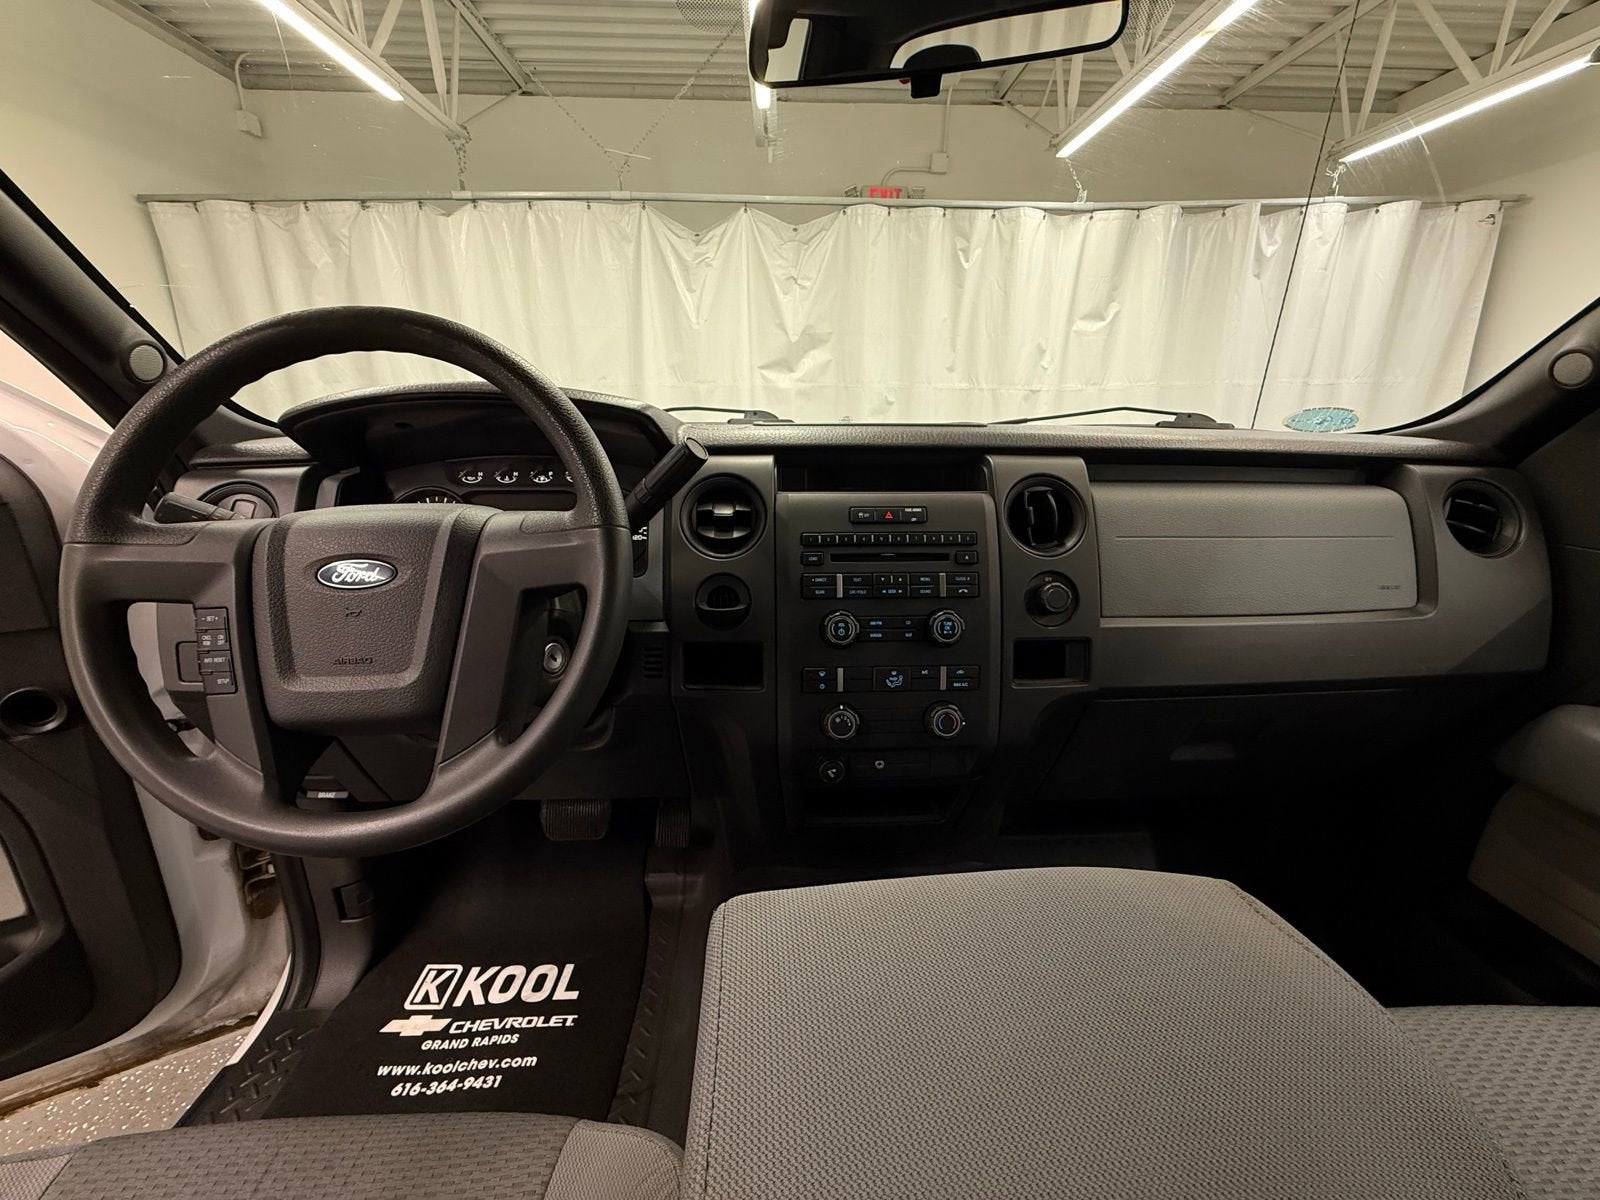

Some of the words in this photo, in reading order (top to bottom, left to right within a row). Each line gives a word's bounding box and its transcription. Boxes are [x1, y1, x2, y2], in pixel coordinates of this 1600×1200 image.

[869, 186, 902, 199] EXIT
[331, 562, 387, 583] Ford
[317, 791, 336, 799] BRAKE
[452, 963, 580, 1008] KOOL
[448, 1014, 579, 1035] CHEVROLET
[420, 1038, 469, 1051] GRAND
[471, 1033, 520, 1048] RAPIDS
[376, 1055, 538, 1077] www.koolchev.com
[390, 1074, 503, 1098] 616-364-9431
